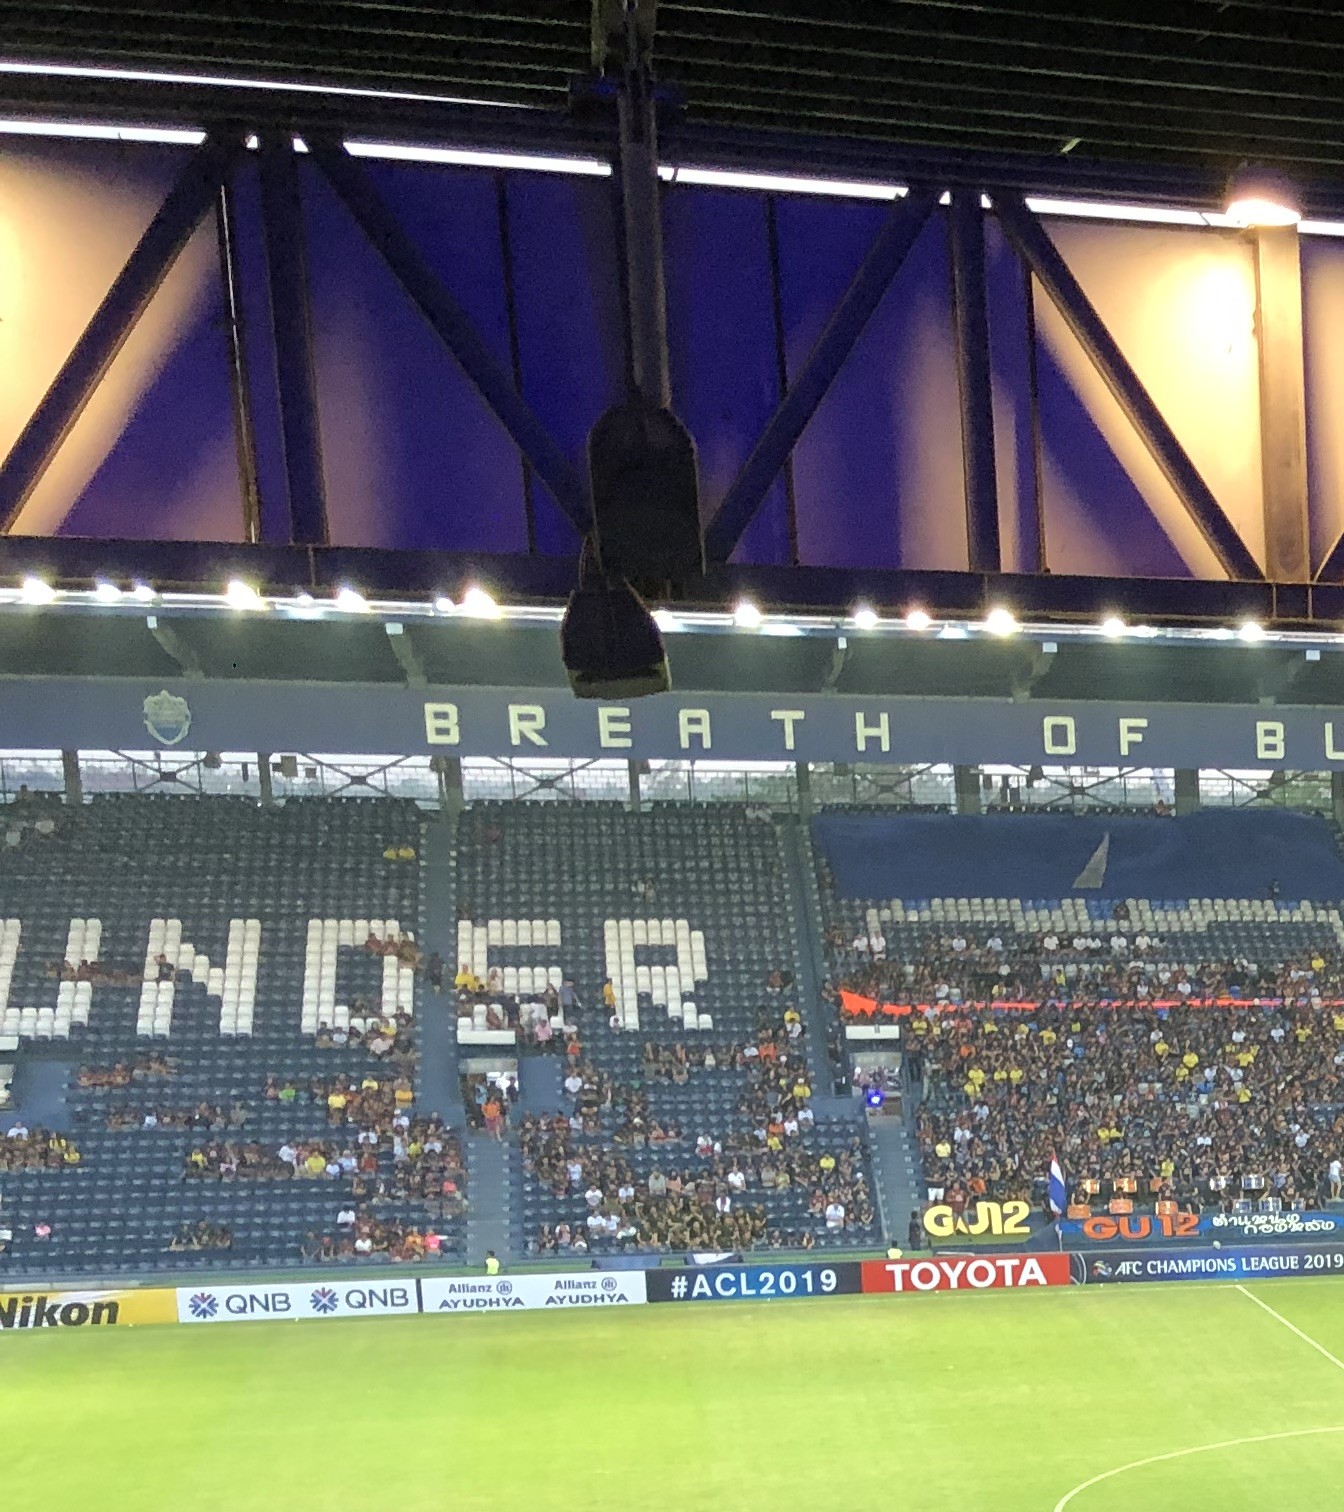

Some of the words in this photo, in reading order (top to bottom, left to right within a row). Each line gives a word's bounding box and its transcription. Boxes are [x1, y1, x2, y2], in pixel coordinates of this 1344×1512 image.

[424, 703, 891, 753] BREATH
[1043, 715, 1148, 755] OF
[886, 1259, 1047, 1291] TOYOTA
[1115, 1261, 1142, 1276] AFC
[1147, 1257, 1236, 1275] CHAMPIONS
[1241, 1255, 1299, 1271] LEAGUE
[1303, 1253, 1344, 1270] 2019
[448, 1282, 493, 1295] Allianz
[554, 1278, 597, 1291] Allianz
[671, 1269, 837, 1298] #ACL2019
[225, 1292, 291, 1314] QNB
[345, 1288, 408, 1309] QNB
[439, 1297, 525, 1310] AYUDHYA
[545, 1292, 629, 1305] AYUDHYA
